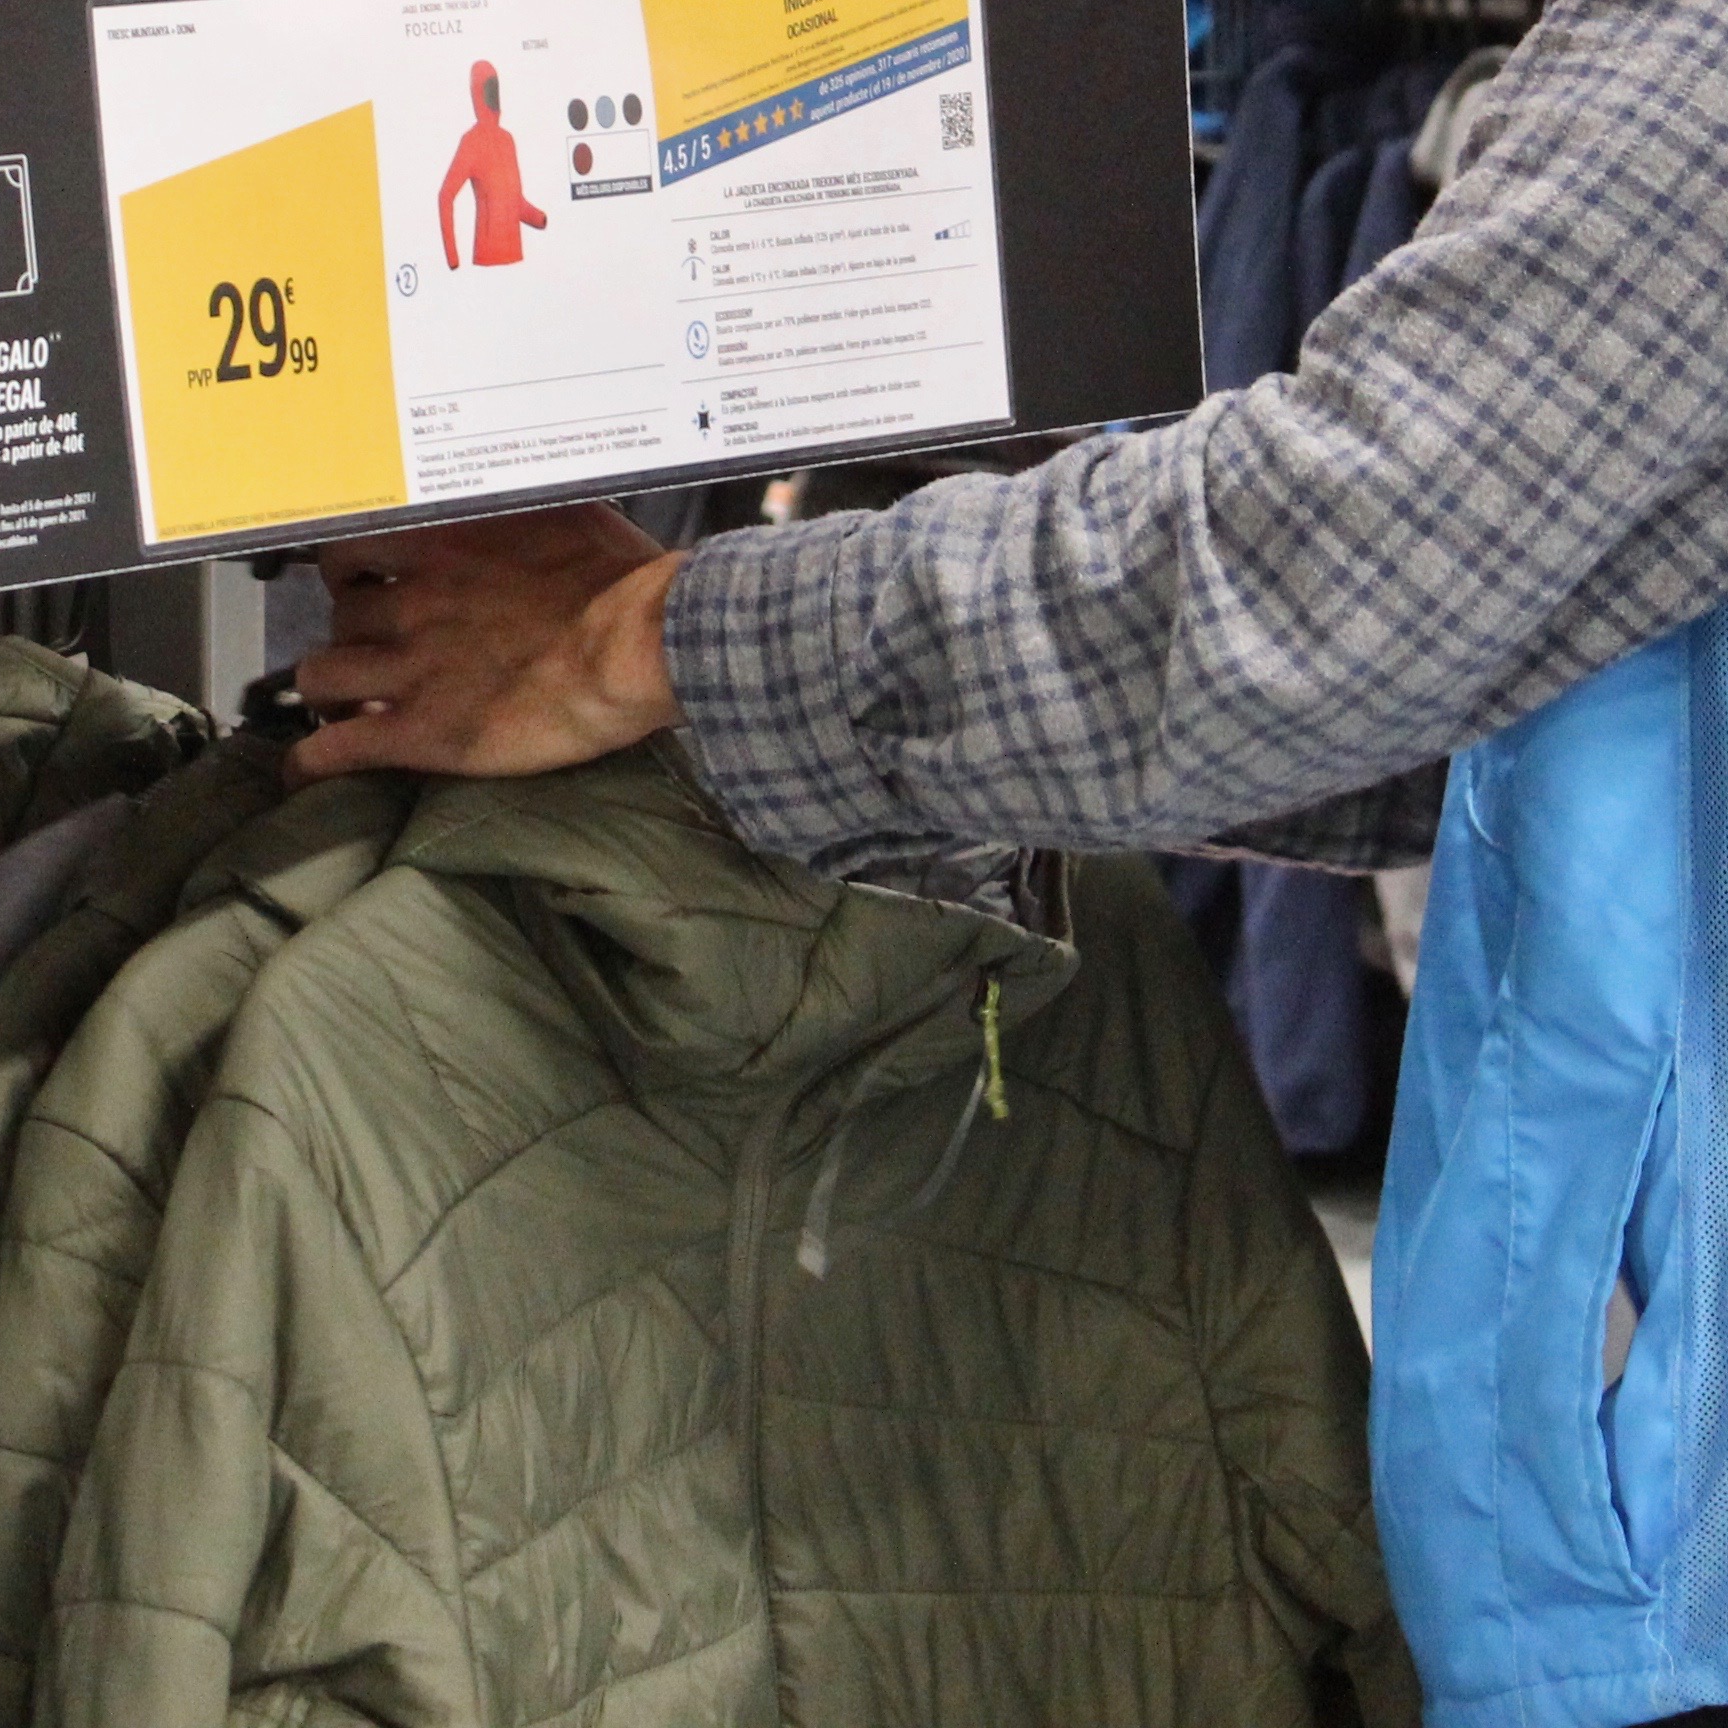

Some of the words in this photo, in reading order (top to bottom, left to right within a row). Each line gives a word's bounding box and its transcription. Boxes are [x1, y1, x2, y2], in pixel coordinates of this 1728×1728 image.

[405, 20, 463, 37] FORCLAZ
[188, 368, 213, 389] PVP
[4, 417, 38, 444] partir
[38, 417, 54, 437] de
[55, 411, 78, 432] 40€
[11, 438, 44, 465] partir
[45, 436, 60, 456] de
[62, 432, 83, 453] 40€
